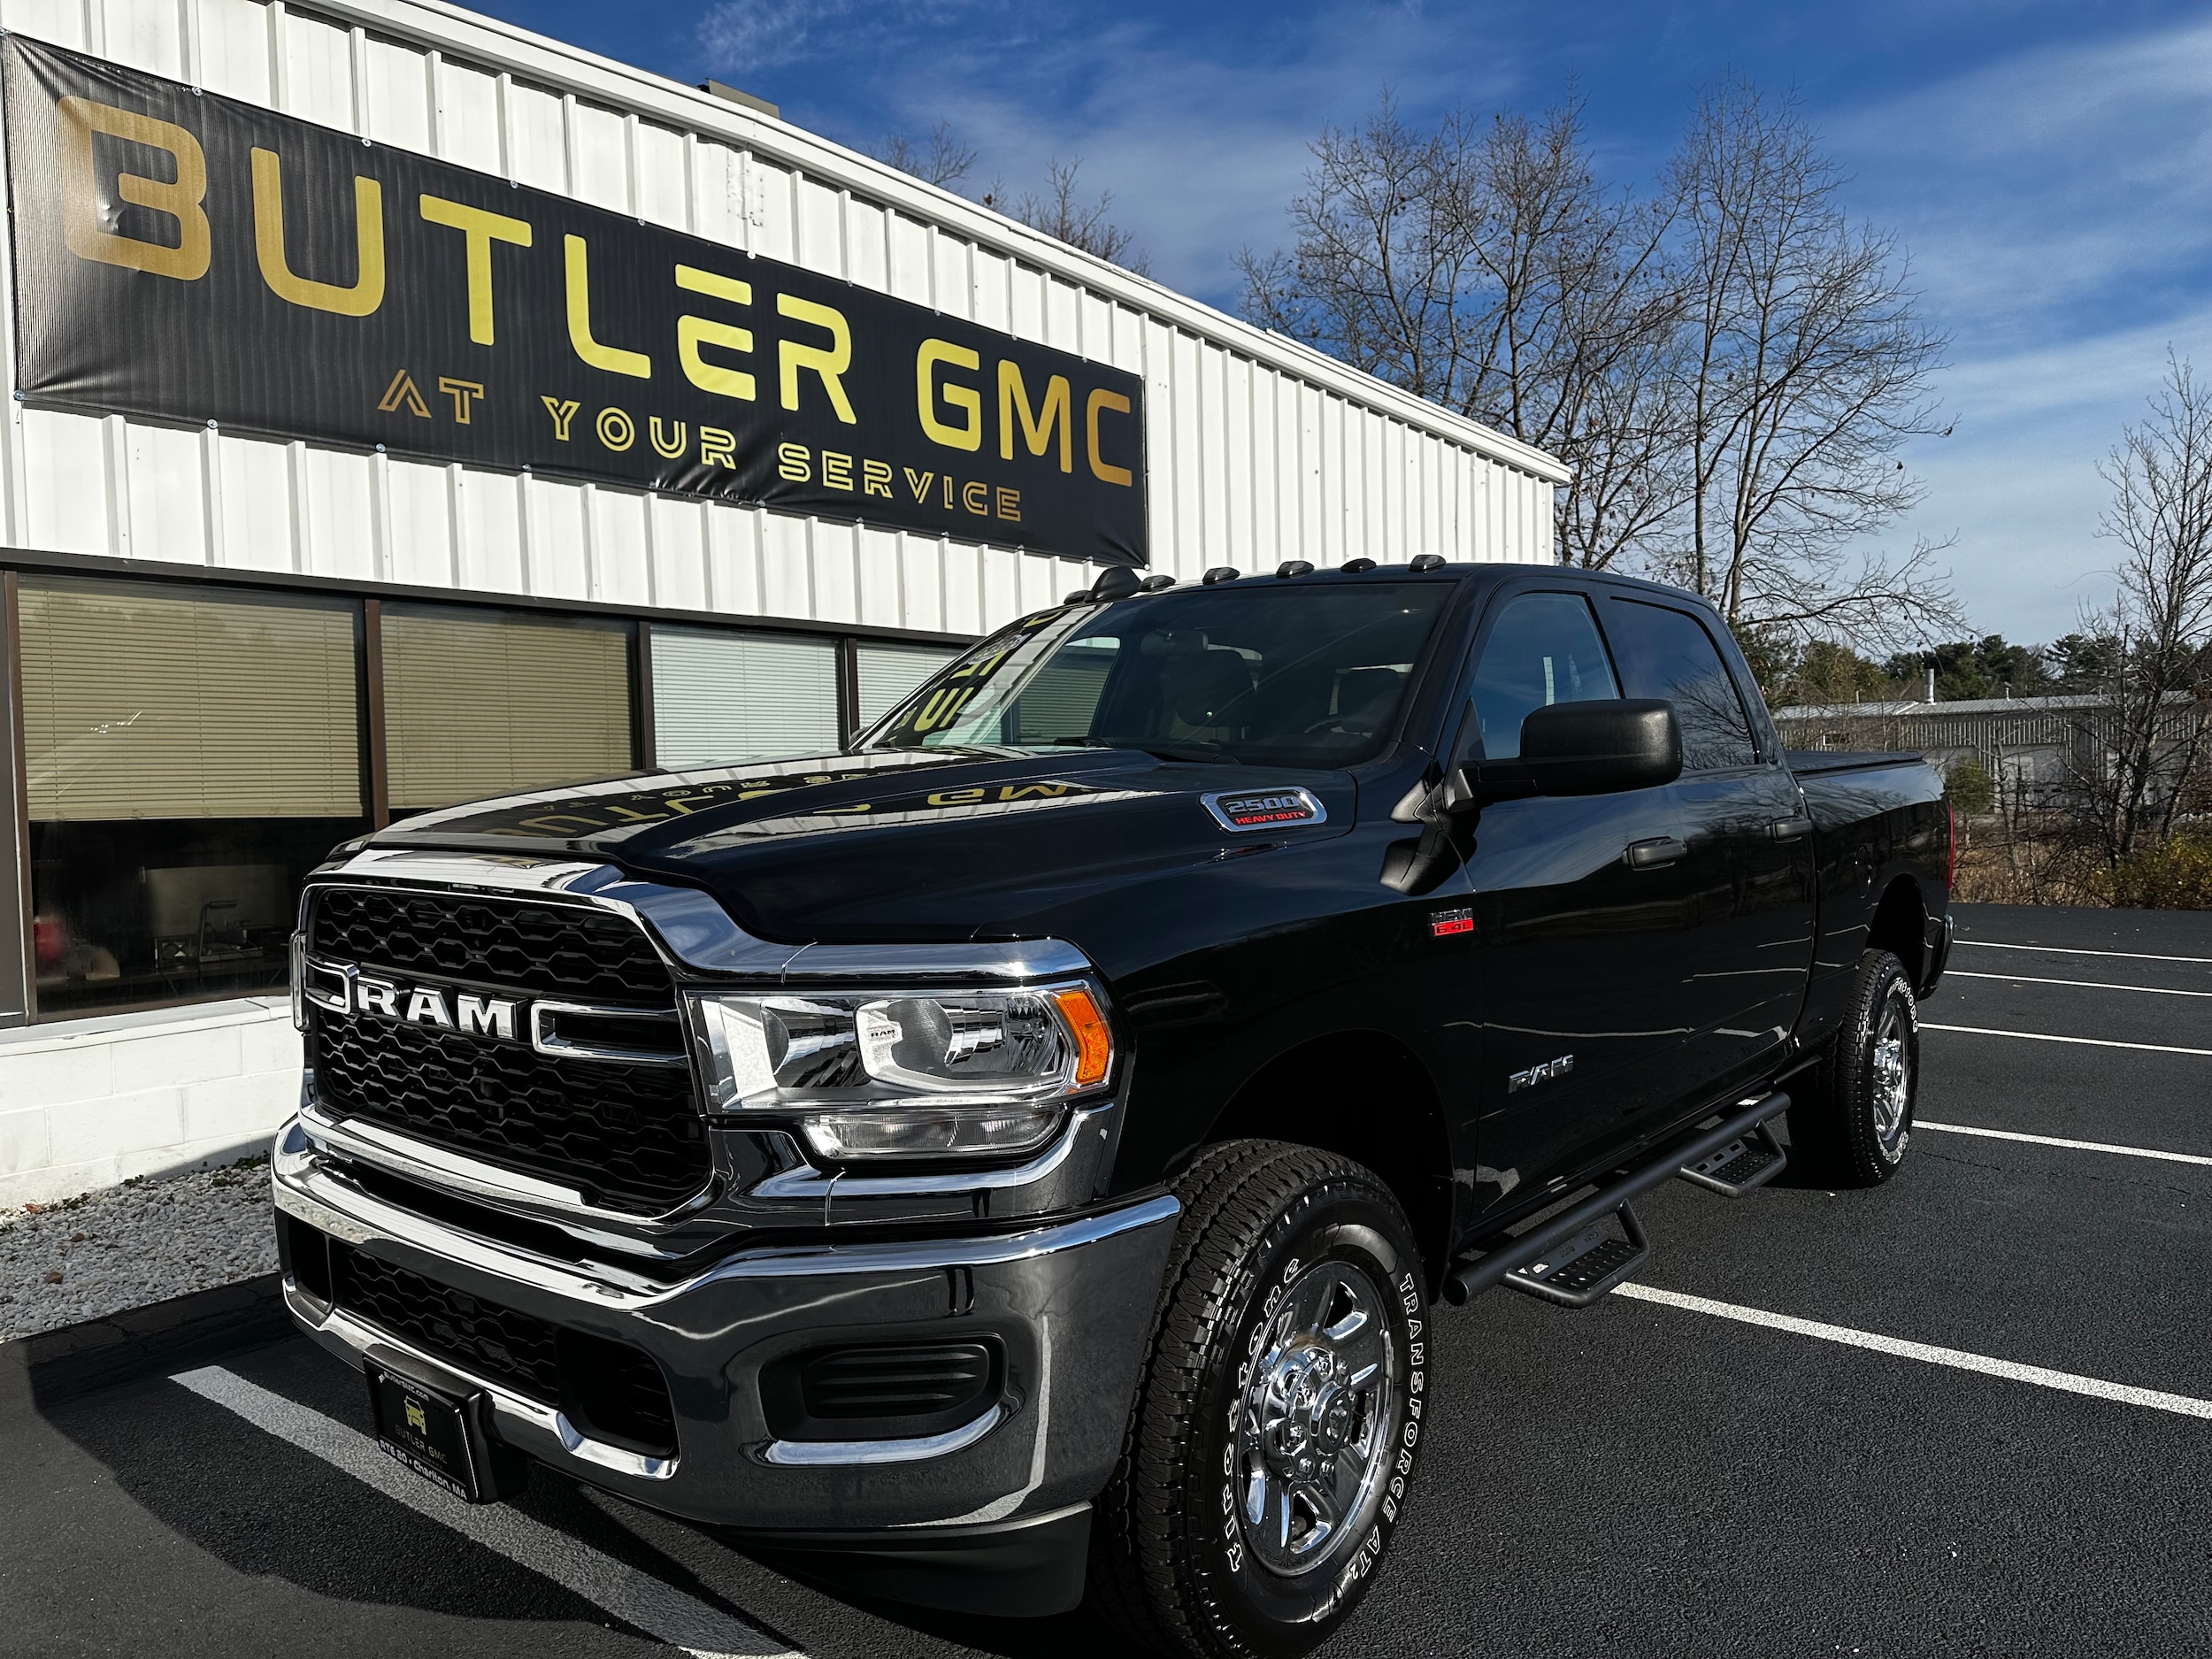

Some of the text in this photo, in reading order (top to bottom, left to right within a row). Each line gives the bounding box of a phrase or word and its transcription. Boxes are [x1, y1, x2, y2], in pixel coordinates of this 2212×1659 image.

[58, 95, 1133, 488] BUTLER GMC
[377, 368, 1022, 522] AT YOUR SERVICE
[1225, 795, 1300, 814] 2500
[1235, 810, 1307, 825] HEAVY DUTY
[1429, 907, 1473, 924] HEMI
[1436, 922, 1471, 934] 6.4L
[357, 974, 529, 1041] RAM
[1508, 1053, 1574, 1094] RAM
[1380, 1272, 1425, 1523] TRANSFORCE
[395, 1424, 426, 1454] BUTLER
[427, 1445, 448, 1465] GMC
[396, 1449, 407, 1463] 20
[451, 1481, 468, 1502] MA
